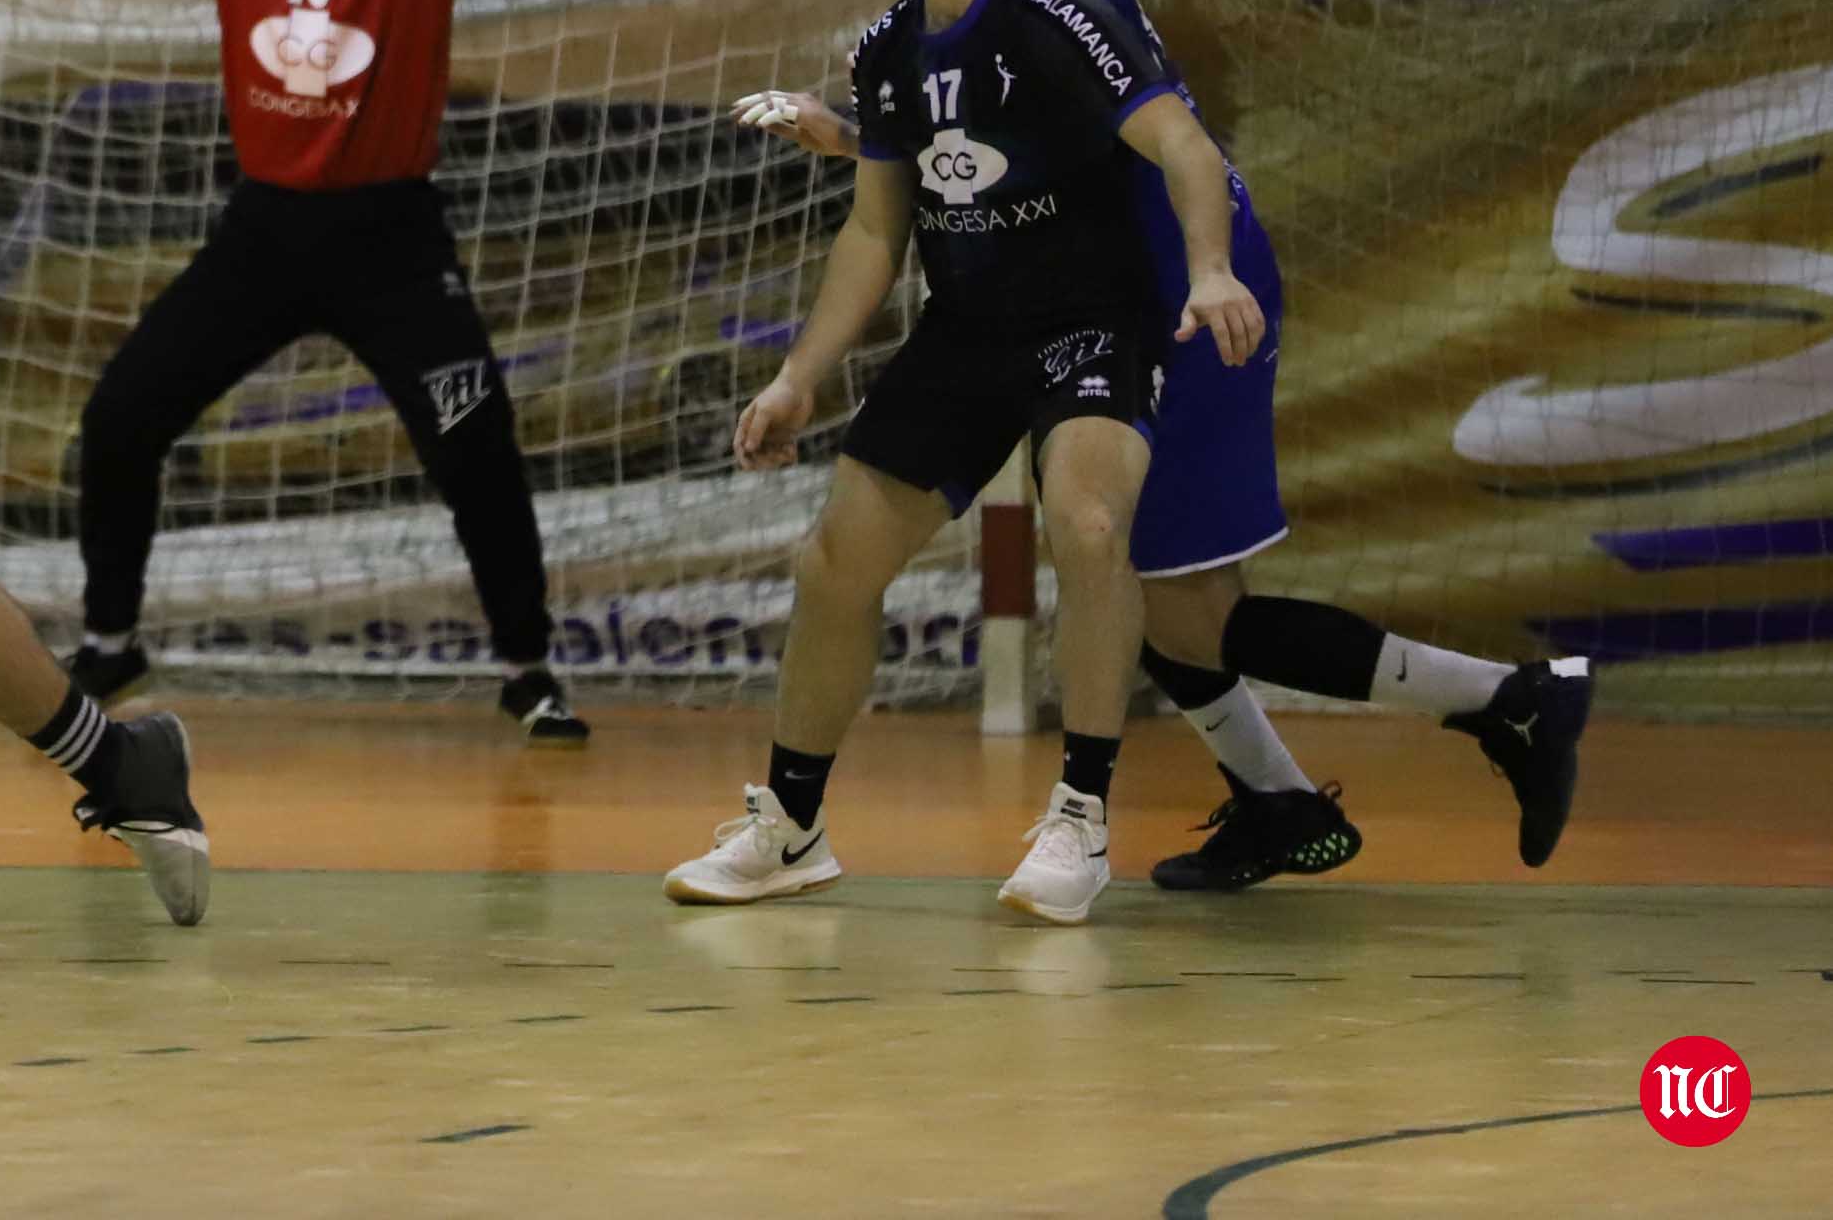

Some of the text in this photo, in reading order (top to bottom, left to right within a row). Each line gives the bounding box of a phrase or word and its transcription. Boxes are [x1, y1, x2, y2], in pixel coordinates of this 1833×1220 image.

[276, 35, 340, 72] CG
[921, 68, 963, 123] 17
[930, 151, 978, 181] CG
[917, 193, 1058, 233] ONGESA XXI
